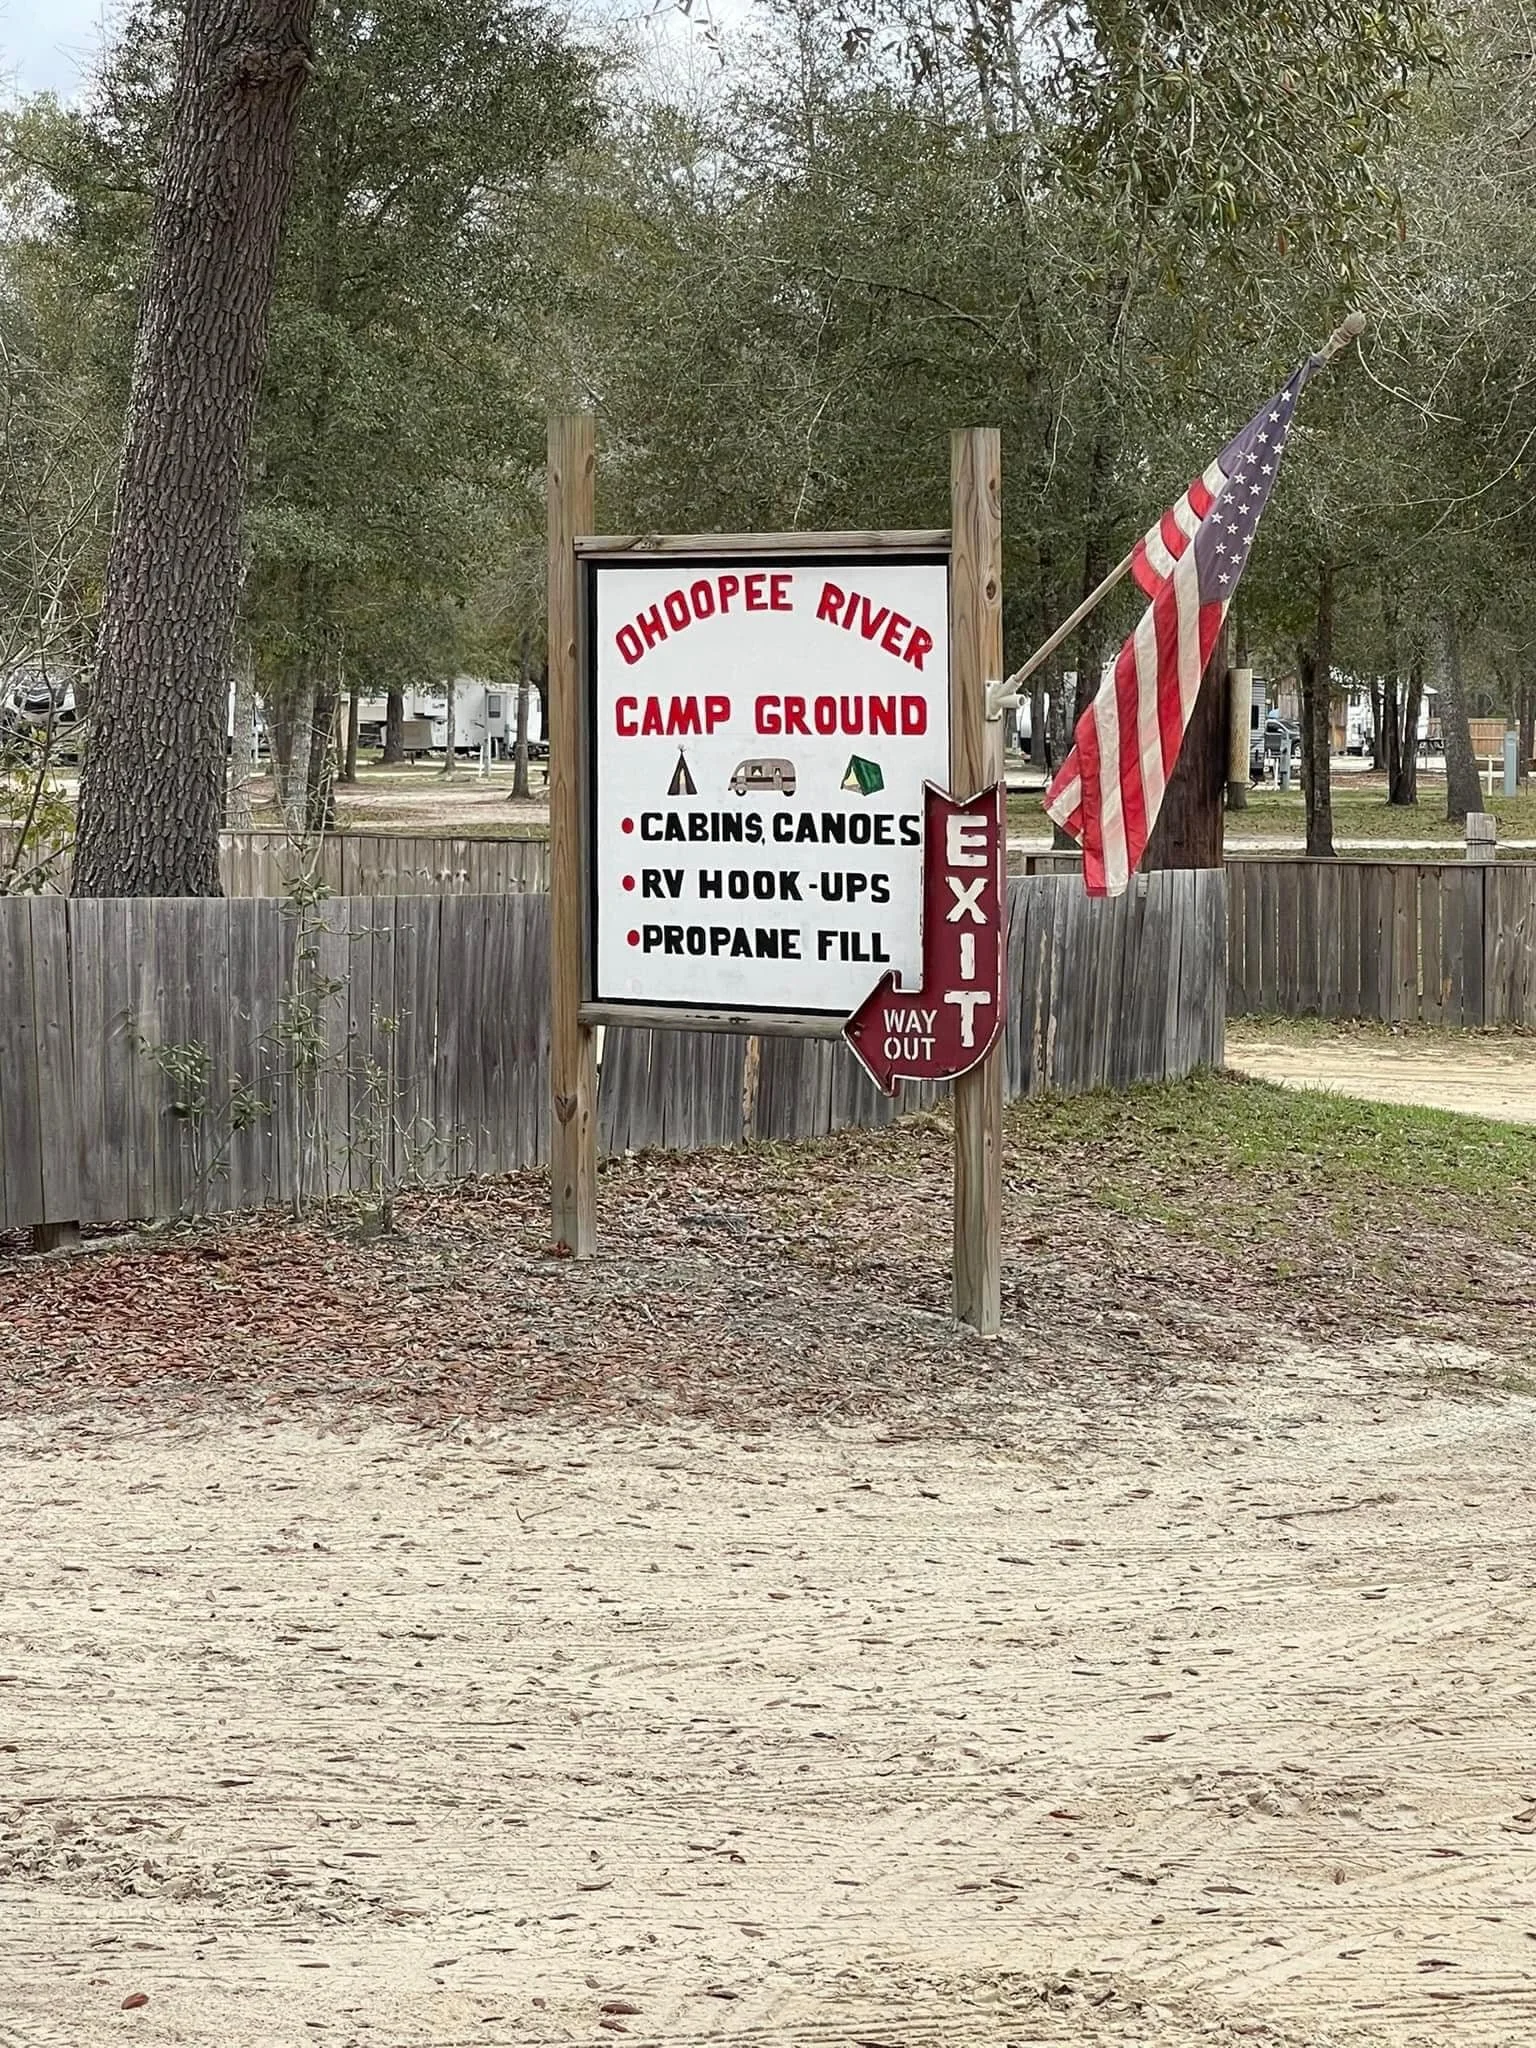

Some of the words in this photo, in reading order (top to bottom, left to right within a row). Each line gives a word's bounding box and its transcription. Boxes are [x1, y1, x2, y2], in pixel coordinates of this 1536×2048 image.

[615, 573, 793, 665] OHOOPEE
[816, 582, 933, 672] RIVER
[615, 695, 731, 737] CAMP
[754, 694, 928, 736] GROUND
[640, 812, 766, 845] CABINS,
[772, 812, 921, 845] CANOES
[641, 868, 685, 899] RV
[642, 924, 802, 960] PROPANE
[817, 930, 890, 963] FILL
[943, 815, 991, 1048] EXIT
[883, 1009, 937, 1034] WAY
[883, 1037, 936, 1060] OUT
